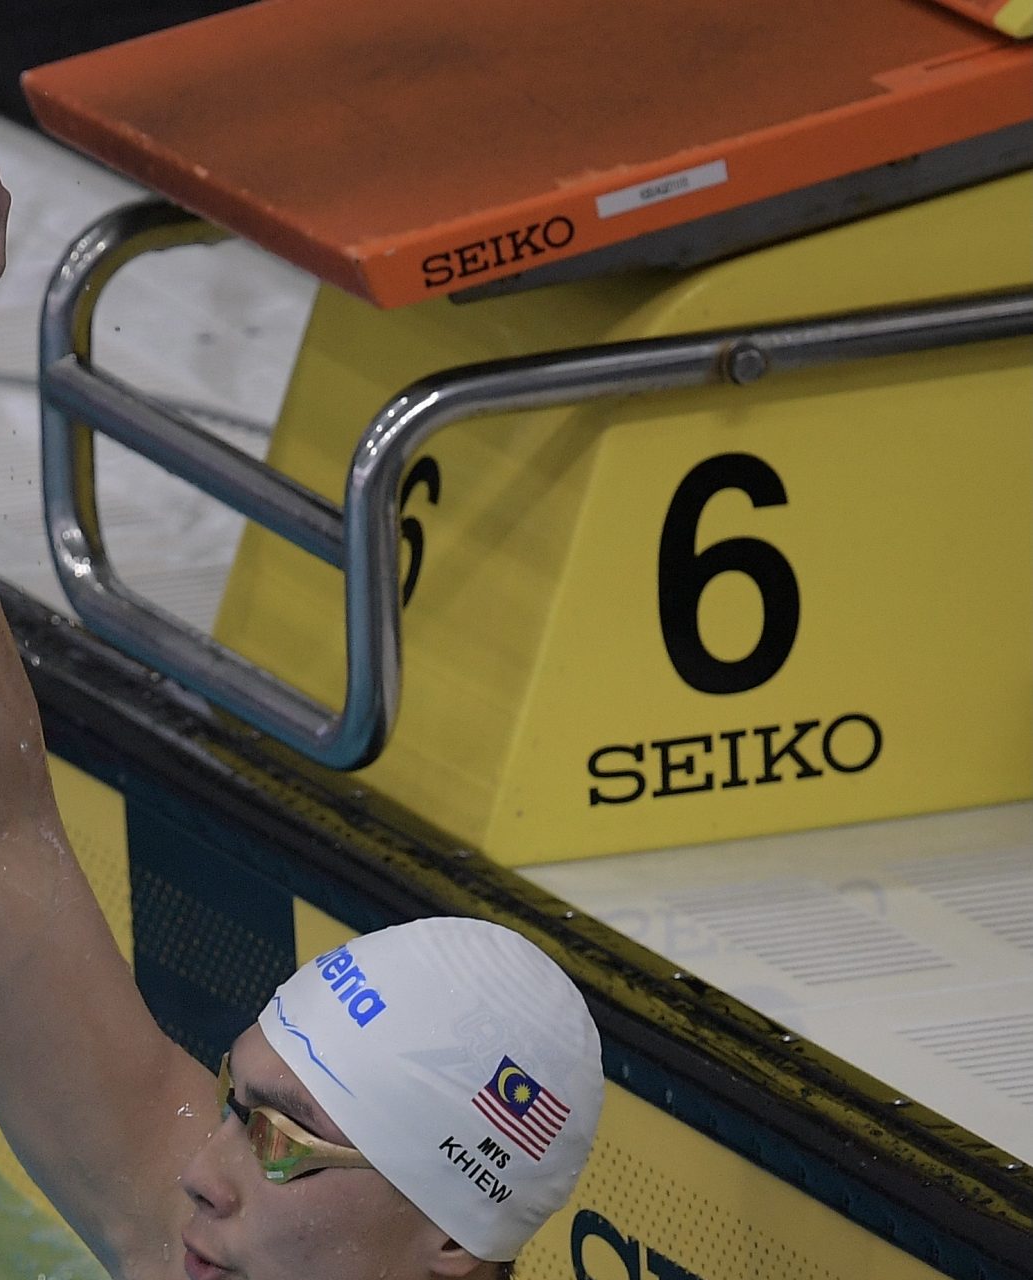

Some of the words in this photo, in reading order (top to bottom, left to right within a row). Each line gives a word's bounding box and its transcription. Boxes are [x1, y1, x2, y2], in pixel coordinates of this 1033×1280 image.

[421, 216, 575, 288] SEIKO
[657, 451, 801, 695] 6
[587, 713, 883, 807] SEIKO
[316, 944, 387, 1028] rena
[438, 1135, 513, 1204] KHIEW
[477, 1136, 511, 1170] MYS
